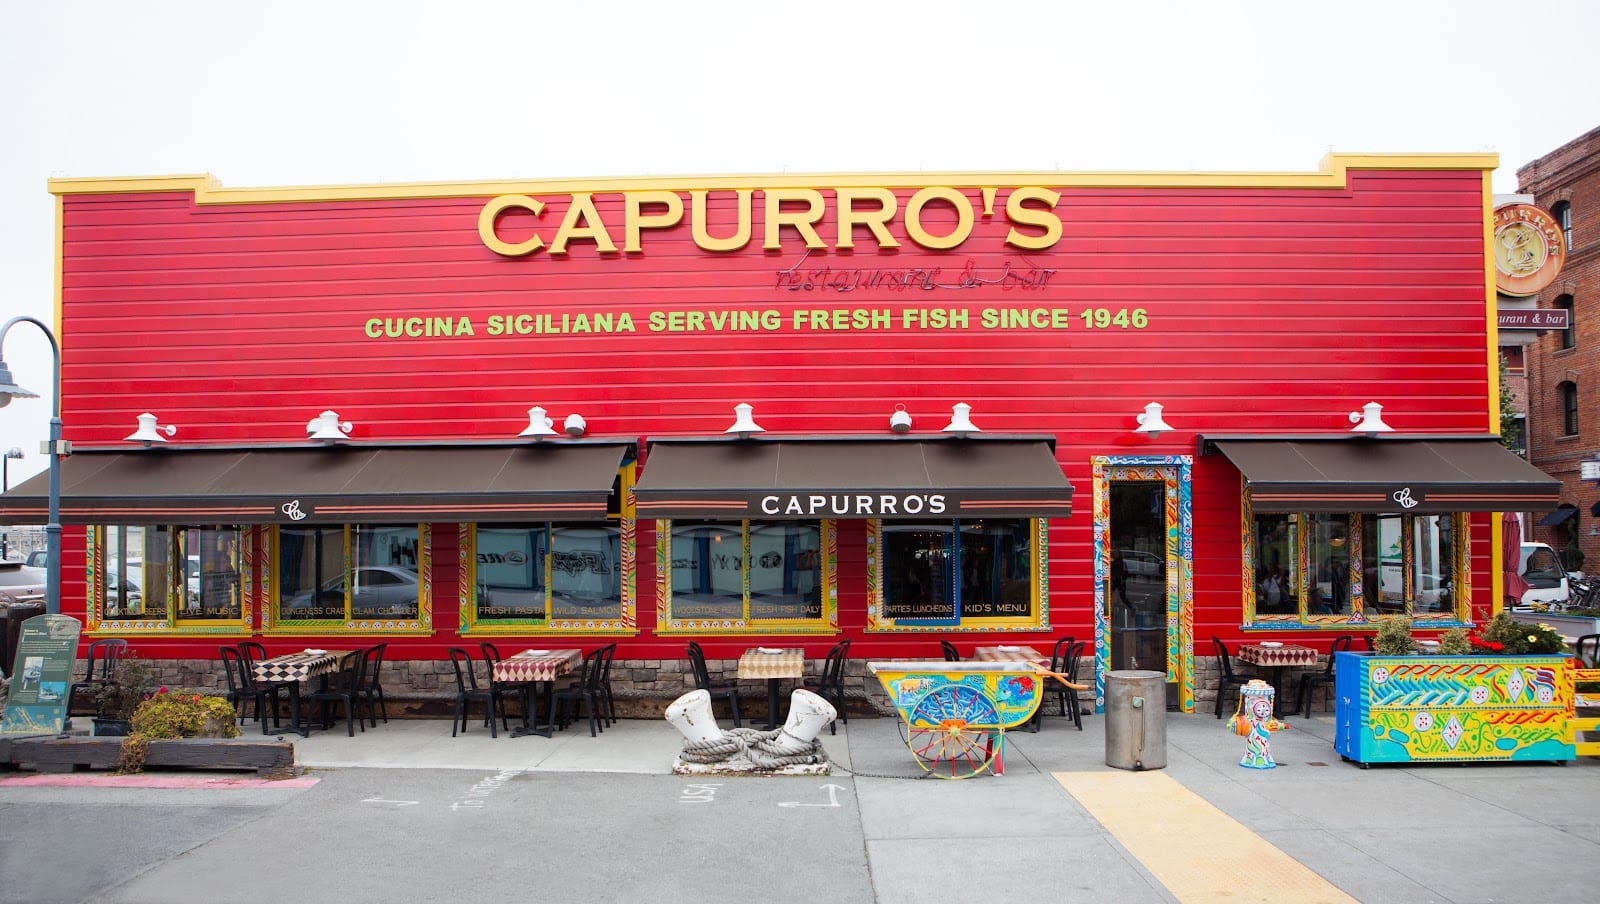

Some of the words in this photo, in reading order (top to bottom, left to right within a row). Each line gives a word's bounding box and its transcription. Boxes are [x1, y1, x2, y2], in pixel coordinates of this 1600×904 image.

[477, 186, 1063, 257] CAPURRO'S
[775, 266, 942, 292] restaurant
[1002, 261, 1057, 291] bar
[364, 316, 475, 338] CUCINA
[486, 312, 636, 335] SICILIANA
[648, 310, 782, 332] SERVING
[792, 308, 892, 331] FRESH
[902, 308, 969, 330] FISH
[980, 308, 1069, 330] SINCE
[1080, 308, 1149, 329] 1946
[1496, 315, 1527, 325] urant
[1532, 313, 1541, 324] &
[1545, 313, 1565, 324] bar
[761, 494, 946, 515] CAPURRO'S
[145, 607, 167, 616] BEERS
[181, 607, 204, 616] LIVE
[206, 607, 239, 616] MUSIC
[352, 607, 375, 616] CLAM
[478, 606, 511, 615] FRESH
[514, 606, 546, 615] PASTA
[553, 606, 577, 615] WILD
[580, 606, 620, 615] SALMON
[780, 605, 798, 614] FISH
[800, 605, 820, 614] DAILY
[884, 604, 911, 613] PARTIES
[964, 603, 993, 613] KID'S
[996, 603, 1027, 612] MENU
